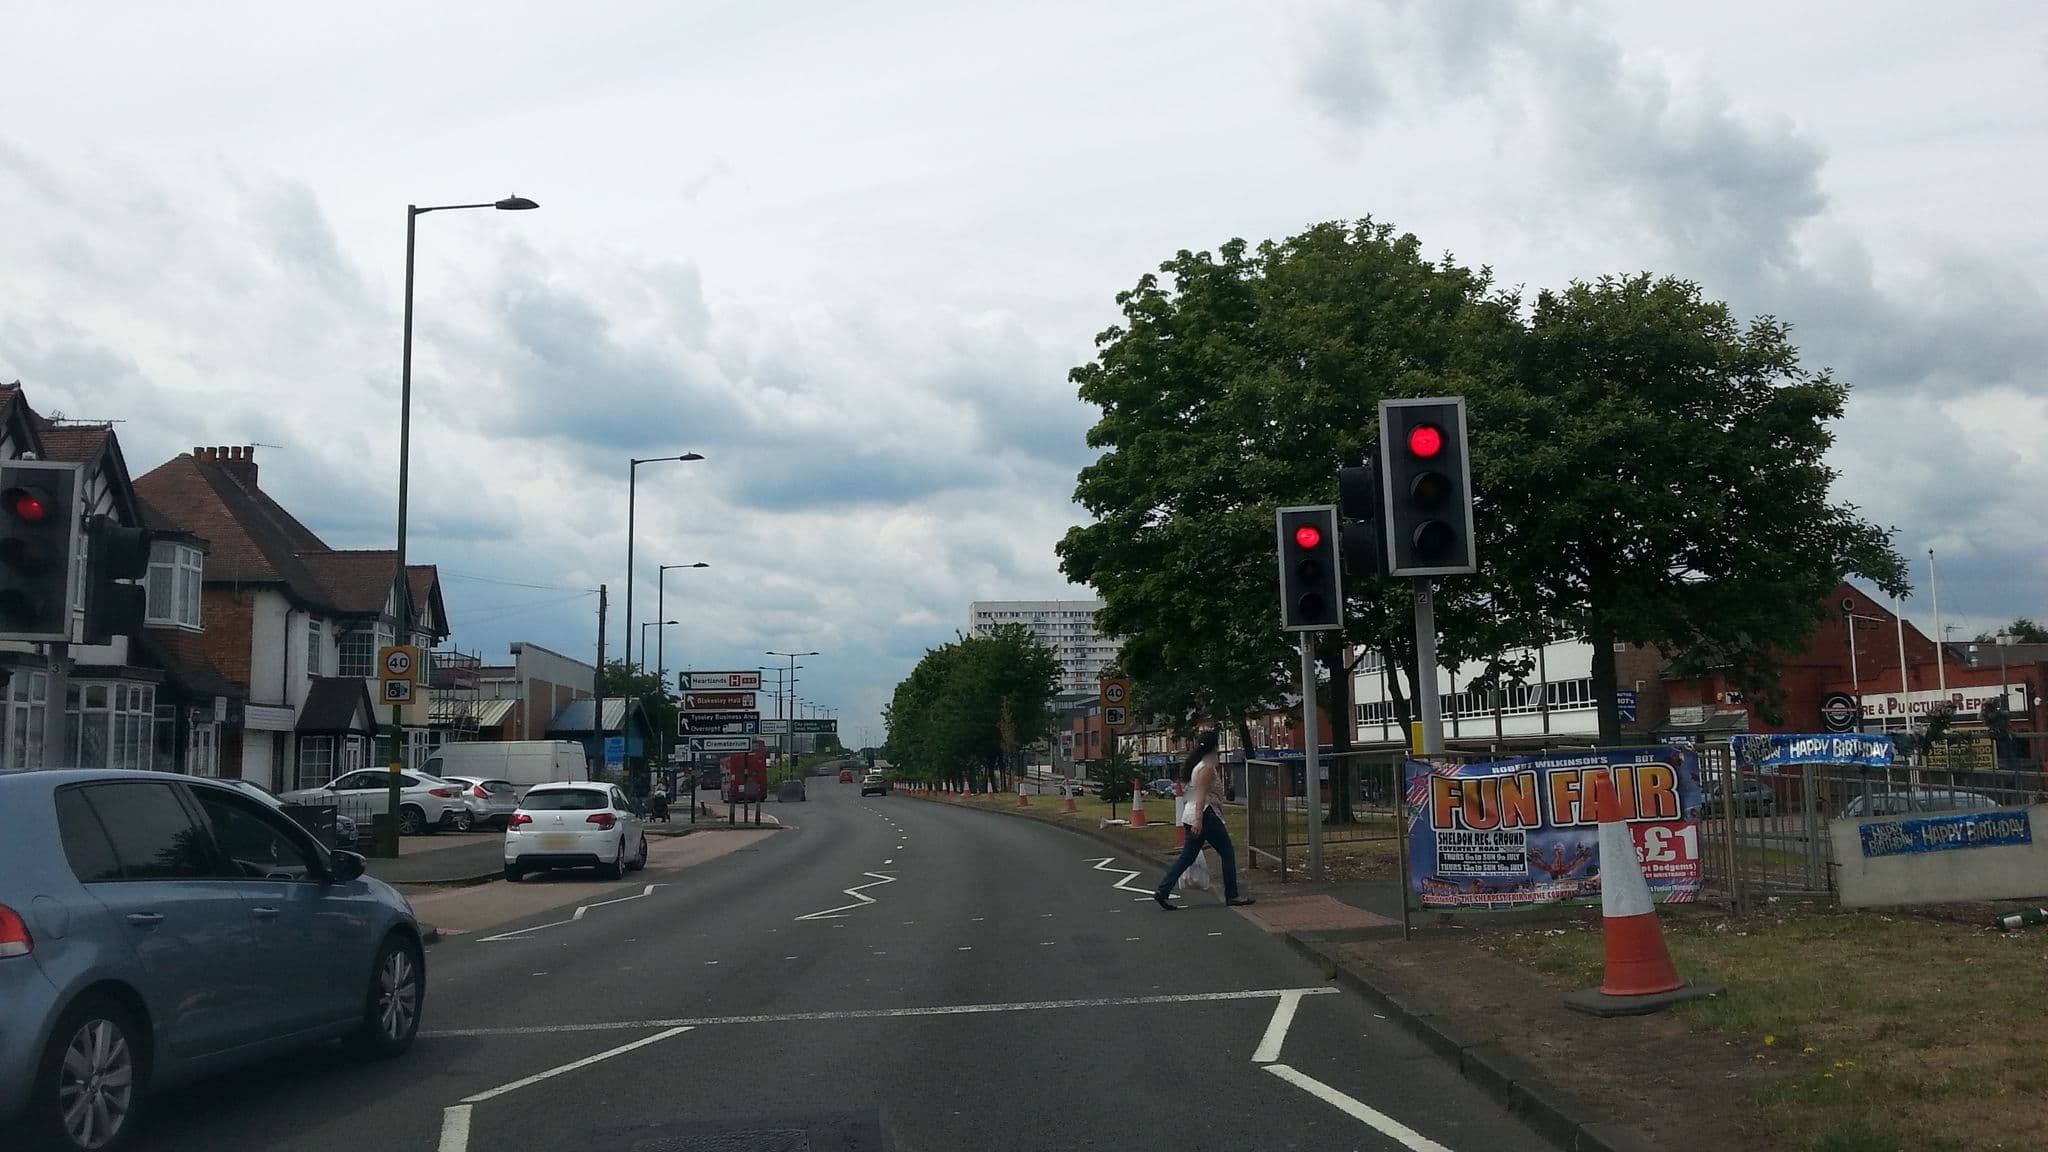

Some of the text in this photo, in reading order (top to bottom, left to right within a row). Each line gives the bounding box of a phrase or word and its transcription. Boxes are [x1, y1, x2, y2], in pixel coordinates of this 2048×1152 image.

[52, 663, 60, 673] 3
[389, 657, 409, 669] 40
[1107, 688, 1123, 698] 40
[697, 697, 726, 705] Blakesley
[690, 725, 721, 733] Overnight
[1789, 738, 1830, 758] HAPPY
[1832, 738, 1889, 759] BIRTHDAY
[1492, 762, 1533, 774] ROBERT
[1535, 756, 1608, 769] WILKINSON'S
[1431, 764, 1681, 830] FUN FAIR
[1438, 831, 1525, 846] SHELDON REC. GROUND
[1871, 818, 2025, 847] HAPPY HAPPY BIRTHDAY
[1644, 824, 1699, 862] £1
[1868, 832, 1914, 856] BIRTHDAY
[1443, 853, 1465, 861] THURS
[1475, 853, 1481, 861] to
[1482, 853, 1496, 861] SUN
[1506, 853, 1520, 861] JULY
[1440, 863, 1463, 871] THURS
[1475, 863, 1482, 871] to
[1510, 863, 1524, 871] JULY
[1474, 893, 1508, 903] CHEAPEST
